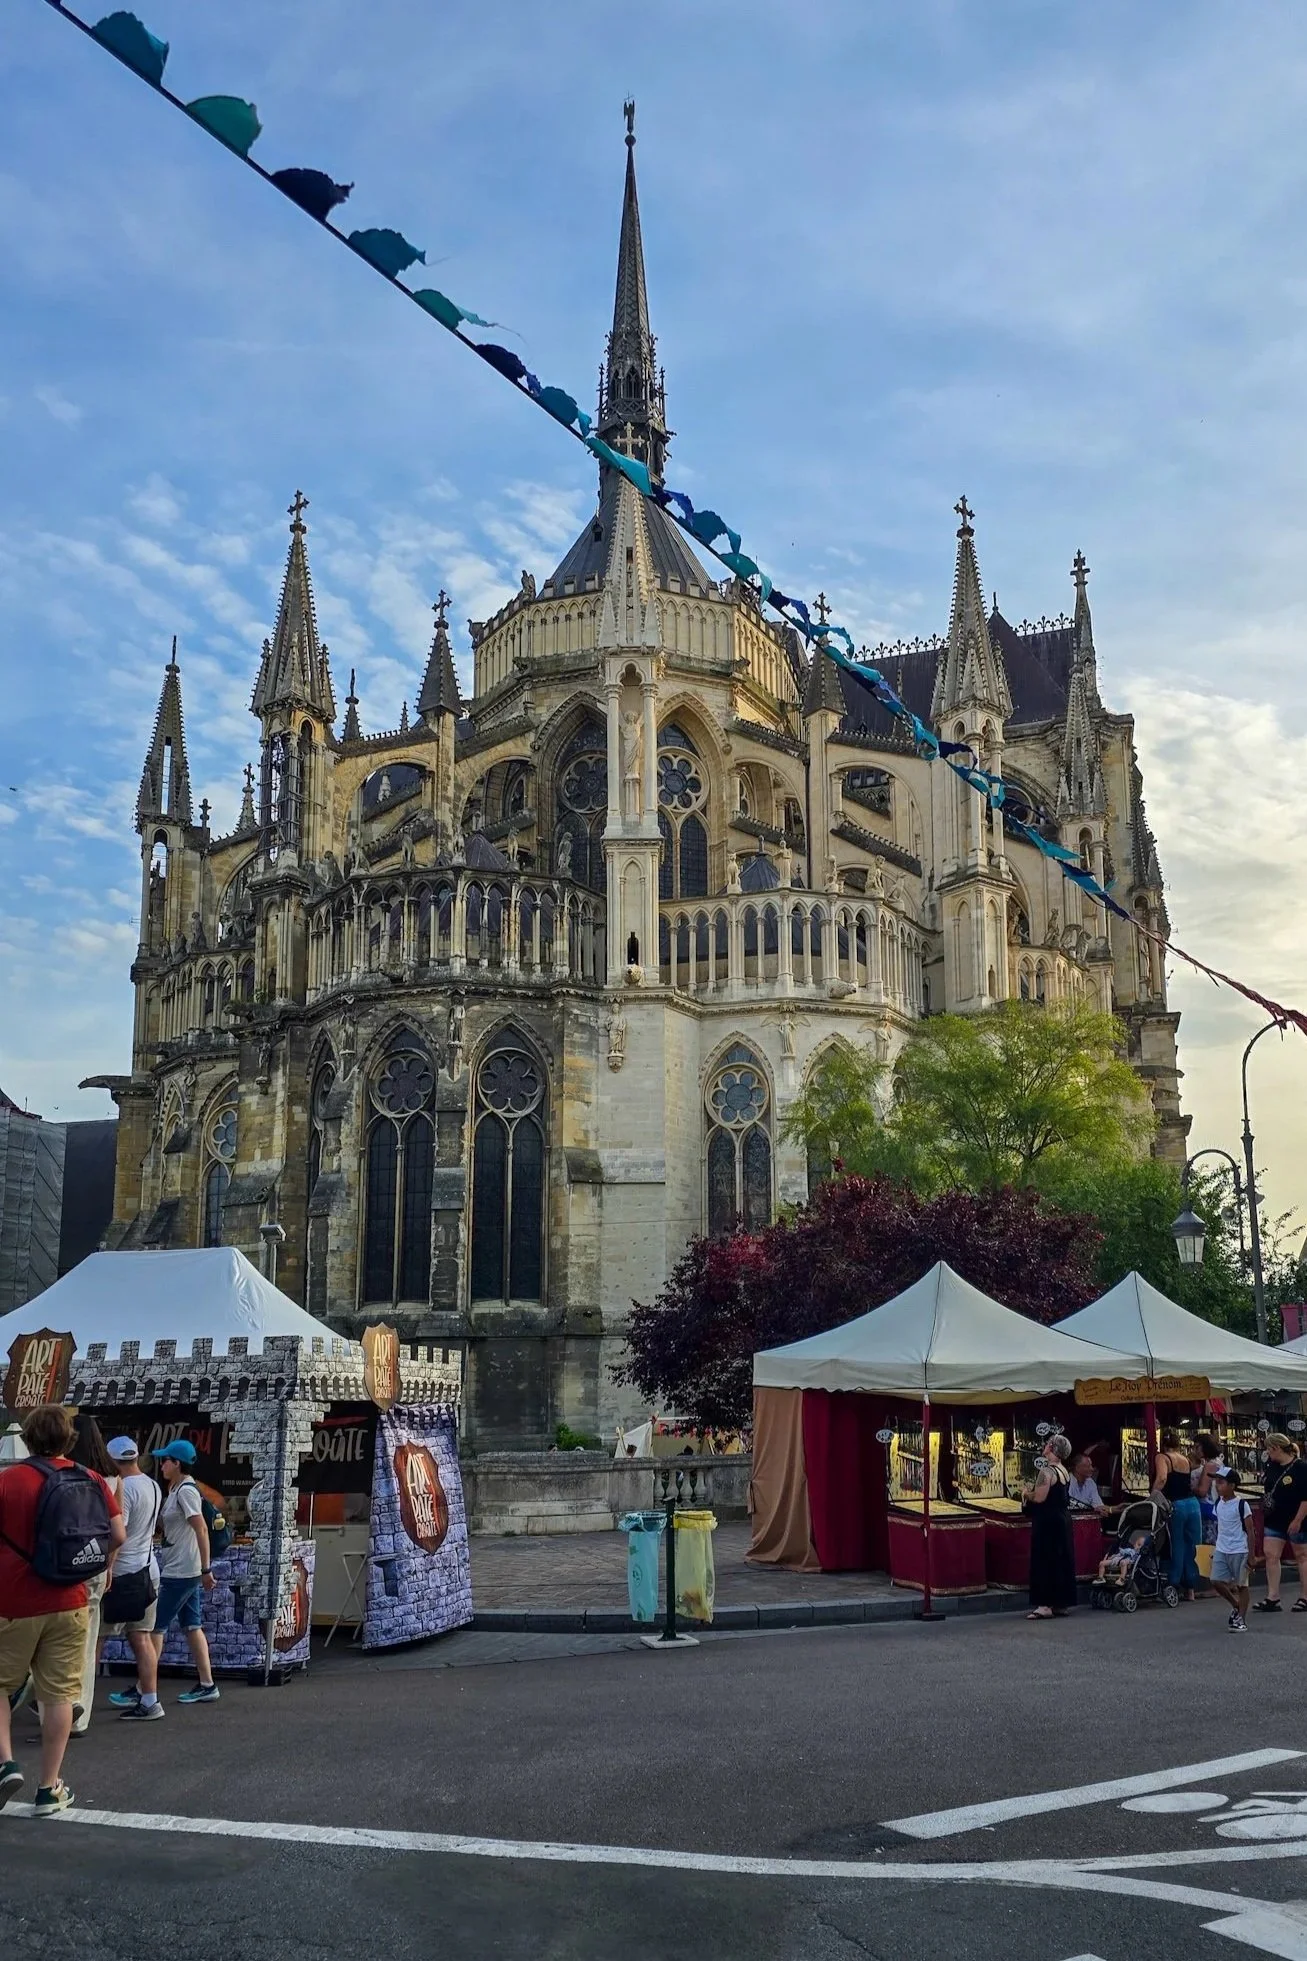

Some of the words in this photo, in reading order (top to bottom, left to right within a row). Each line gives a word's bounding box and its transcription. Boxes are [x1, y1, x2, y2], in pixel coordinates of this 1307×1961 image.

[21, 1338, 62, 1373] ART
[373, 1333, 393, 1366] ART
[300, 1428, 369, 1464] OÛTE
[406, 1452, 431, 1495] ART
[72, 1553, 106, 1565] adidas
[275, 1601, 297, 1626] ATÉ
